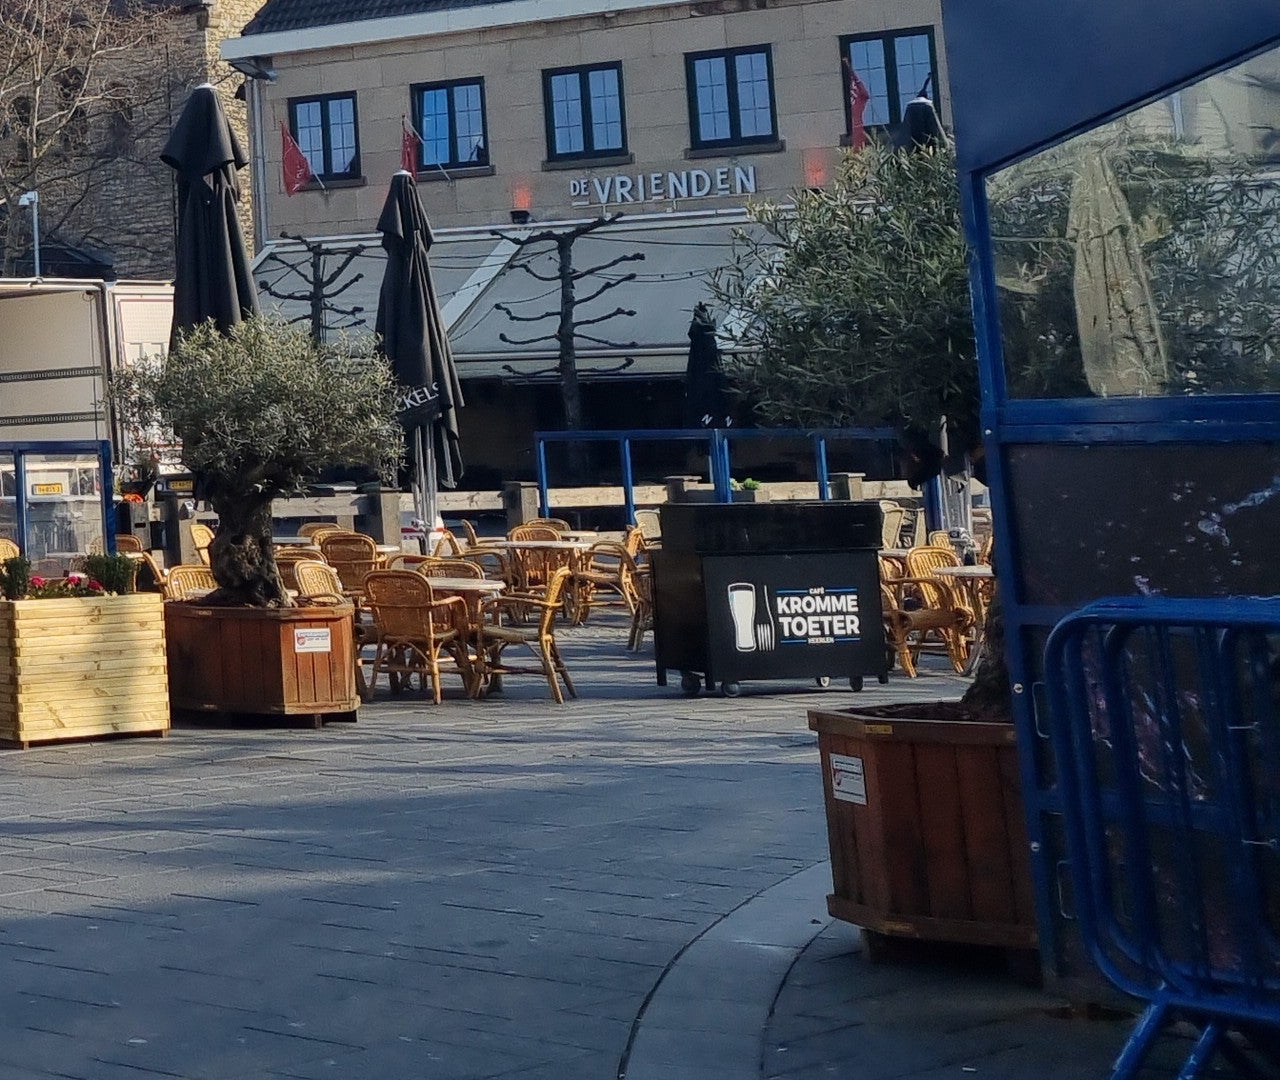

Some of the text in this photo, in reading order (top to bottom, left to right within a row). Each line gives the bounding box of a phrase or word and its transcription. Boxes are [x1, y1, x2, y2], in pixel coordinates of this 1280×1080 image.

[570, 165, 756, 204] DE VRIENDEN
[776, 594, 859, 614] KROMME
[778, 615, 861, 637] TOETER
